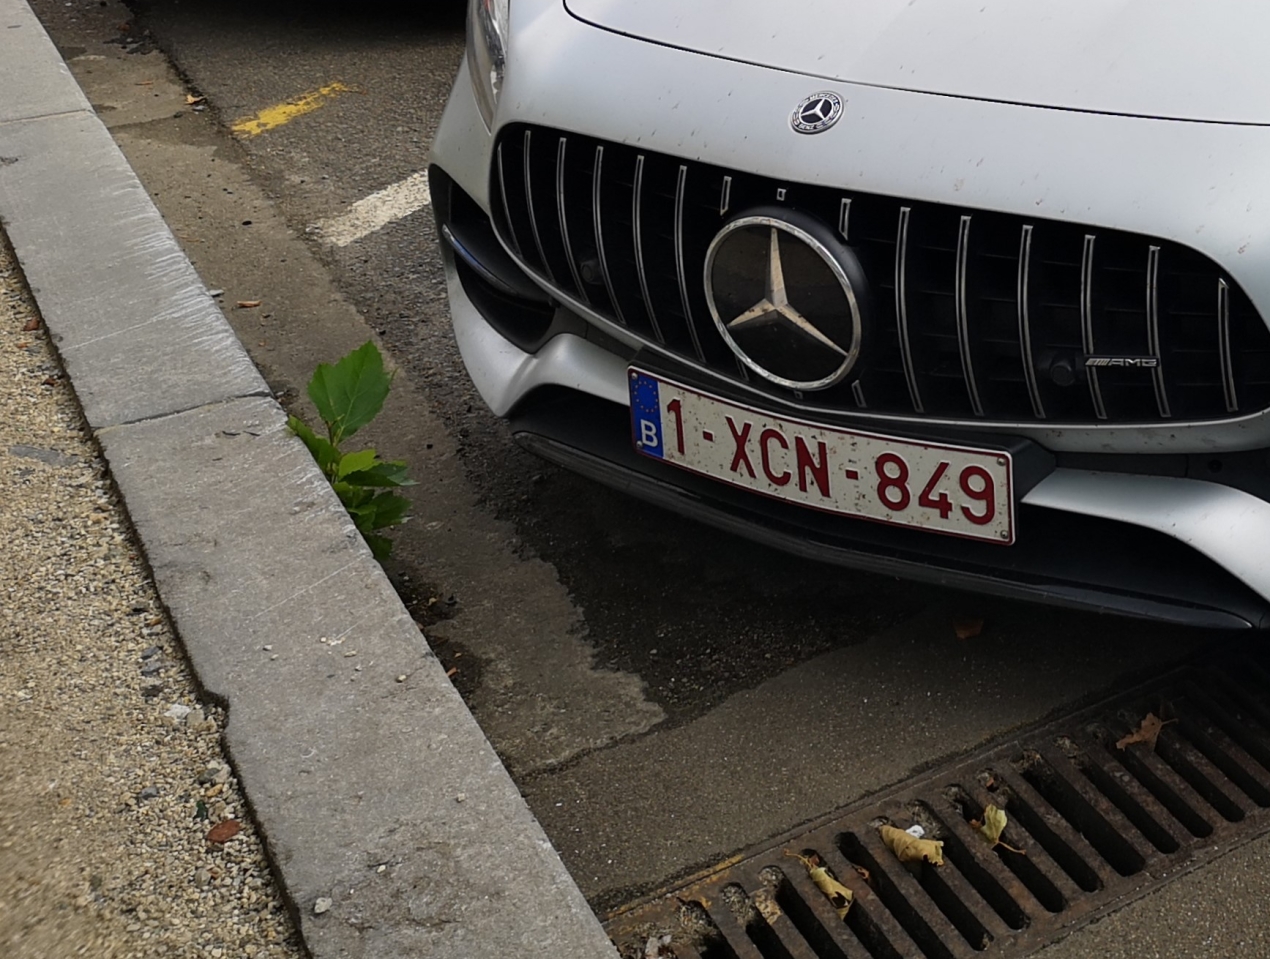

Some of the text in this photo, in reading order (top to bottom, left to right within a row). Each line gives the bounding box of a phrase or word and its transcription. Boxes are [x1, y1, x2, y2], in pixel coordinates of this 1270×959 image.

[1107, 357, 1158, 367] AMG
[640, 398, 996, 526] B 1-XCN-849
